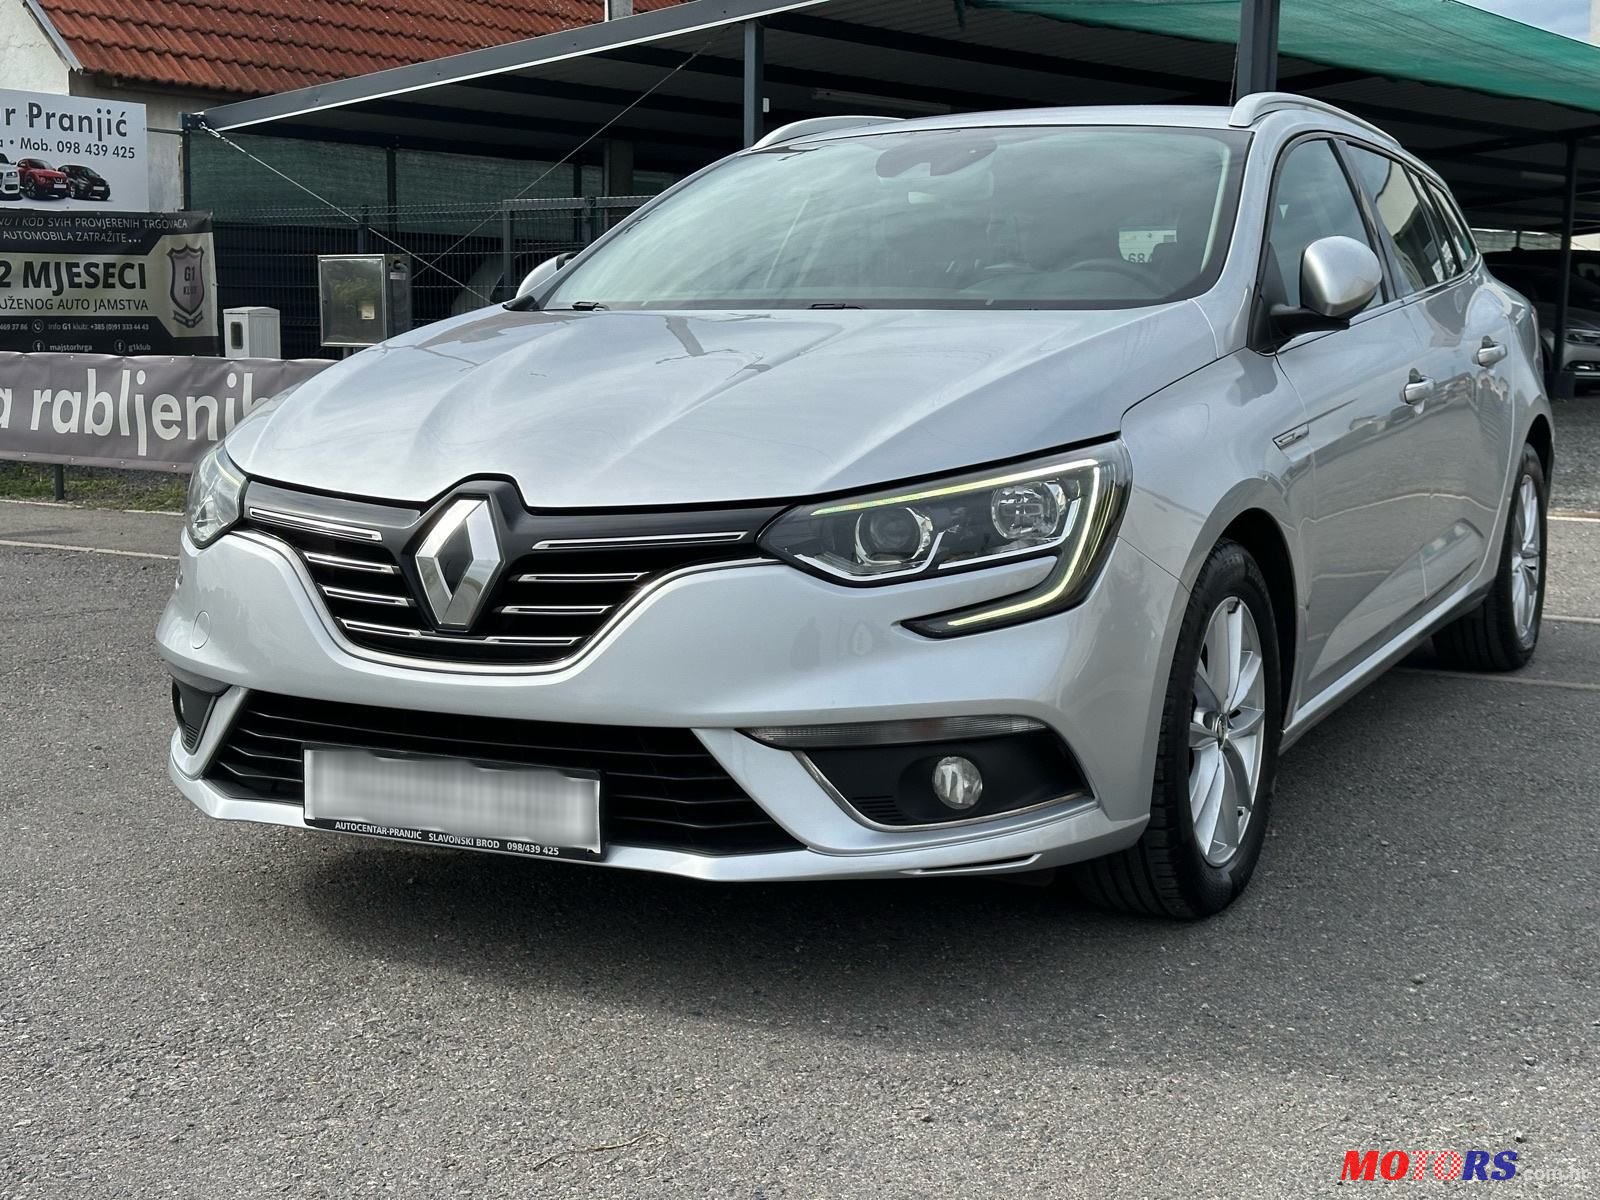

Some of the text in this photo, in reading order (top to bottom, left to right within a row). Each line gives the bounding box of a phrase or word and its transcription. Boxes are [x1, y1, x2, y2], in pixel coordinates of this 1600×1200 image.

[27, 102, 128, 142] Pranjić
[20, 137, 136, 159] Mob. 098 439 425
[22, 217, 44, 227] KOD
[47, 217, 72, 227] SVIH
[75, 217, 140, 229] PROVJERENIH
[3, 230, 74, 241] AUTOMOBILA
[0, 260, 147, 297] 2 MJESECI
[184, 266, 195, 281] G1
[57, 298, 90, 310] AUTO
[93, 299, 149, 313] JAMSTVA
[62, 322, 71, 331] G1
[49, 344, 93, 353] majstorhrga
[428, 832, 474, 847] SLAVONSKI
[476, 837, 500, 850] BROD
[507, 842, 541, 855] 098/439
[542, 845, 560, 857] 425
